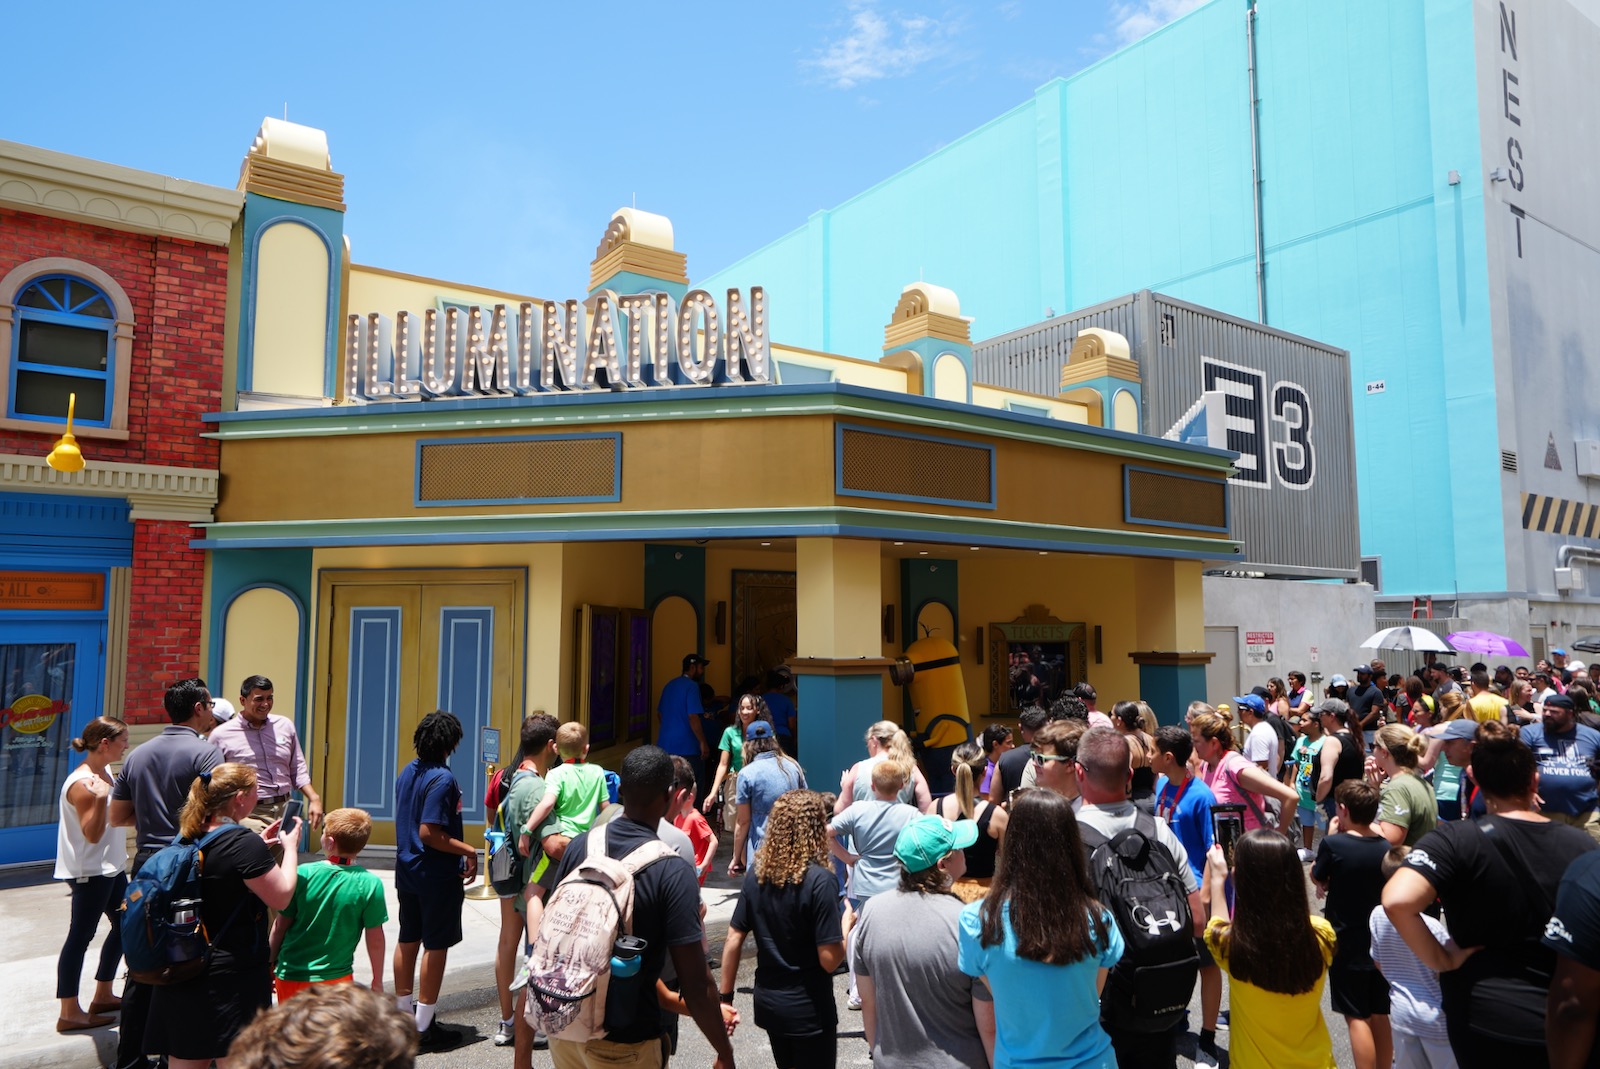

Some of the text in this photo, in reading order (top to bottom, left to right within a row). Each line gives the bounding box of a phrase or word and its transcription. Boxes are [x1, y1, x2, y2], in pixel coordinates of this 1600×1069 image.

[1499, 1, 1526, 259] NEST
[345, 286, 768, 399] ILLUMINATION
[1367, 382, 1384, 391] B-44
[1201, 356, 1316, 490] E3
[8, 582, 31, 598] ALL
[1011, 625, 1065, 640] TICKETS
[1543, 766, 1570, 776] NEVER
